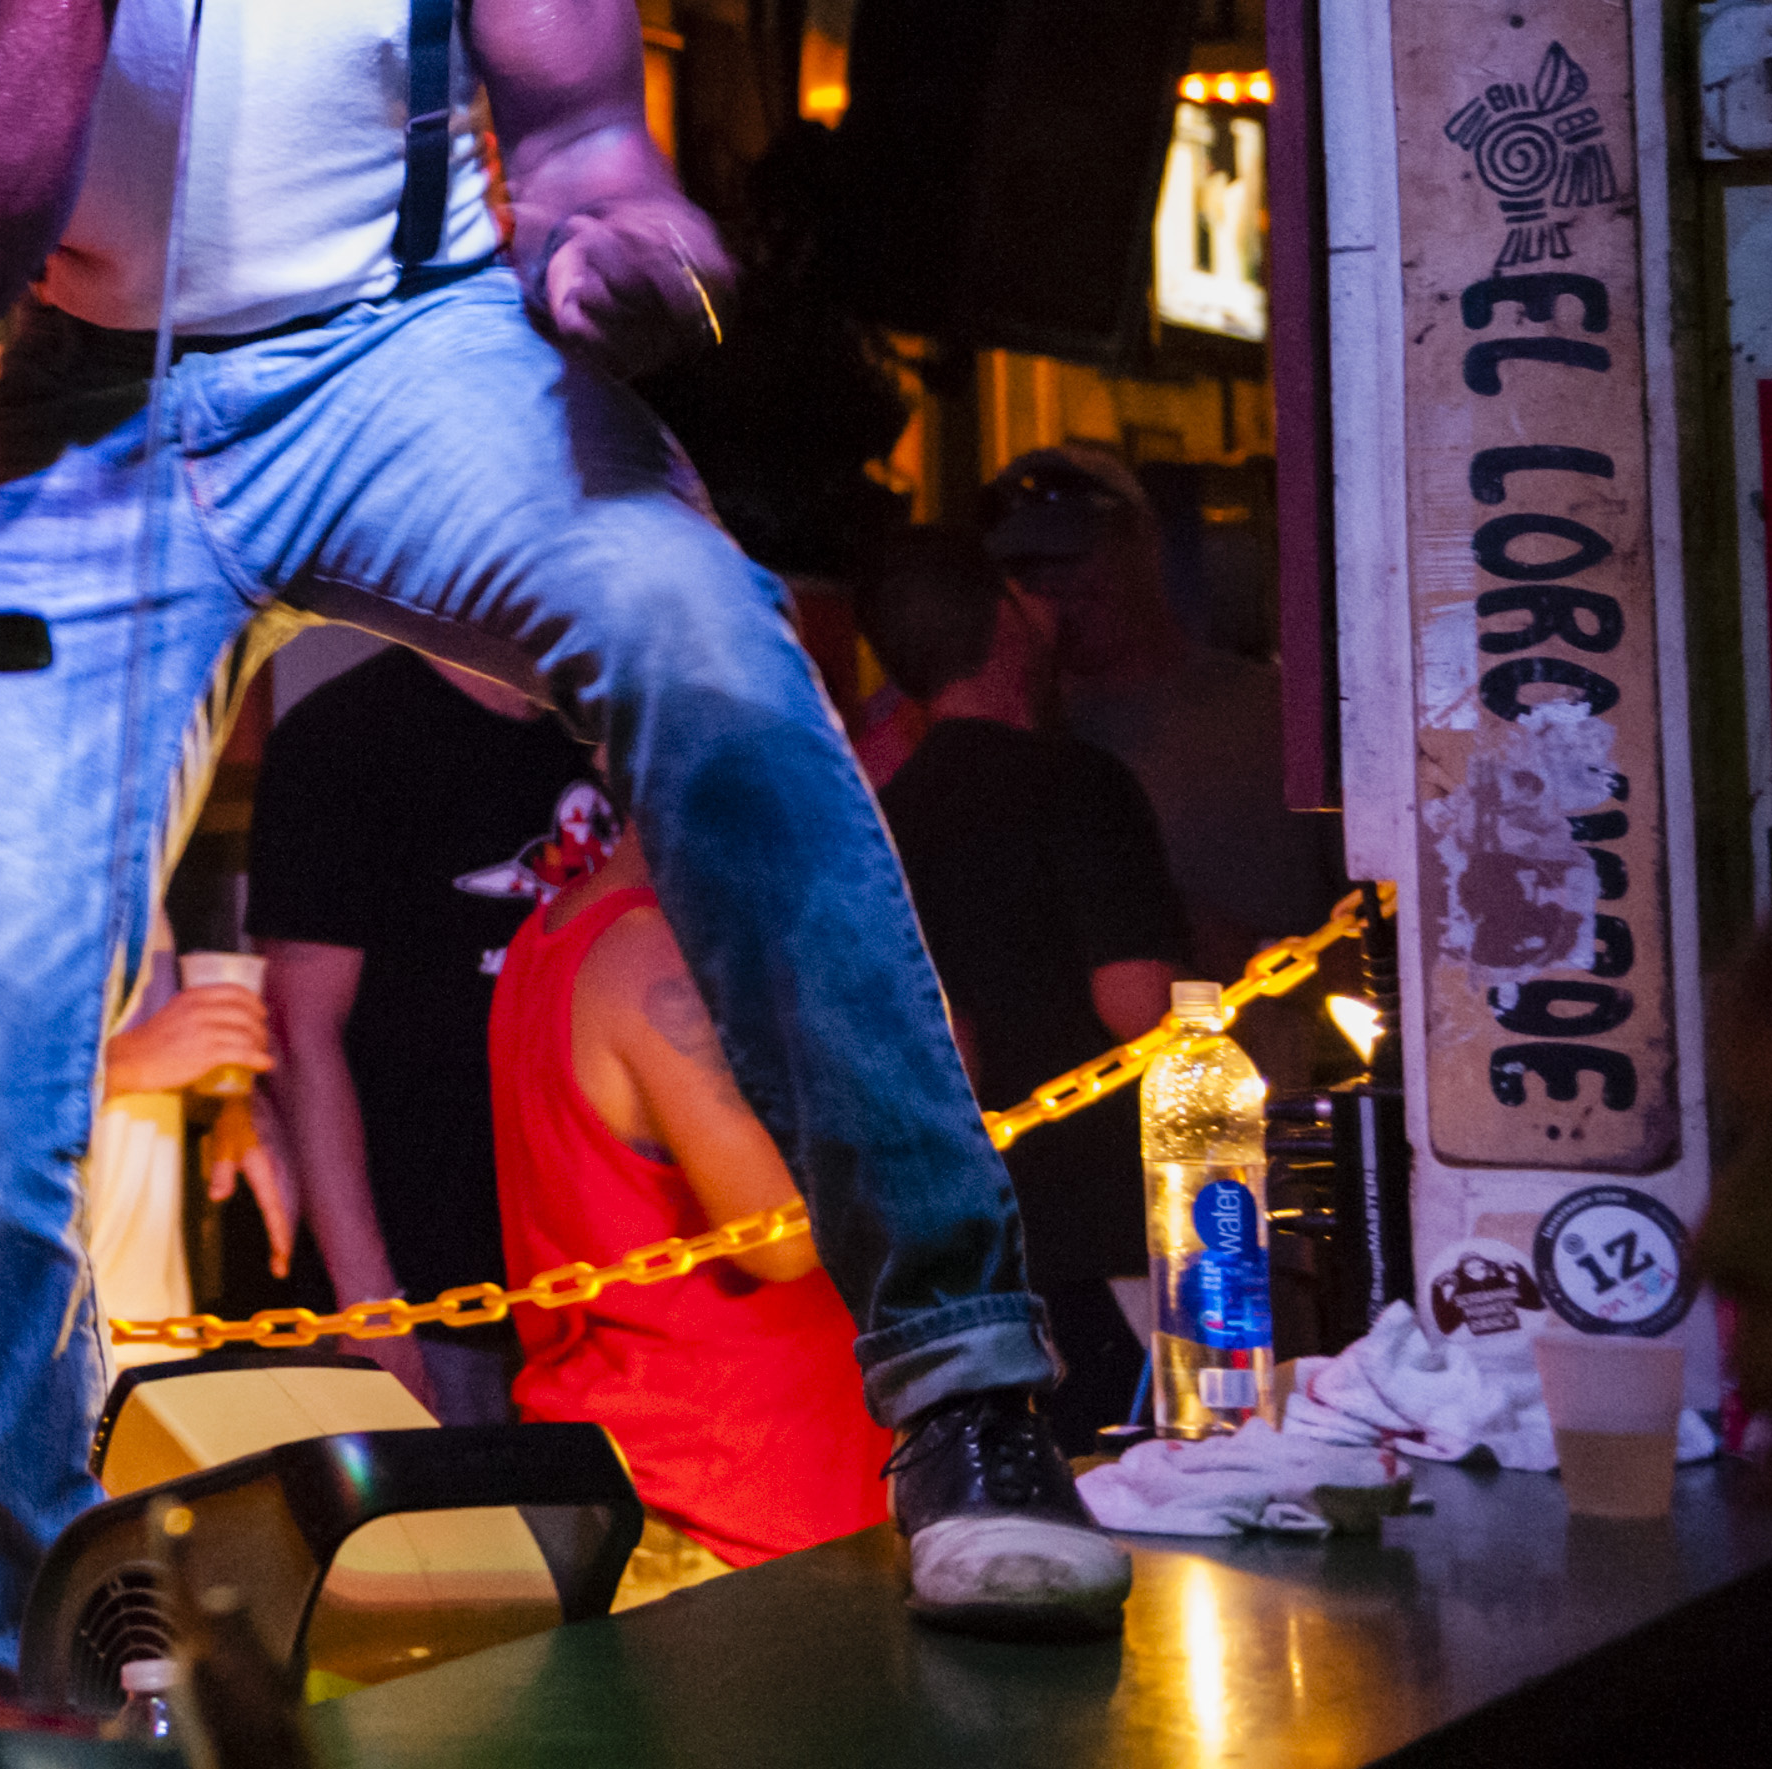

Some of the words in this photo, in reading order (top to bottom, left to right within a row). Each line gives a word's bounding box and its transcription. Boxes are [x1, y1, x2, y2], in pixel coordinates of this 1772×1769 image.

[1461, 272, 1611, 396] EL
[1469, 444, 1625, 723] LORO
[1212, 1184, 1243, 1256] water
